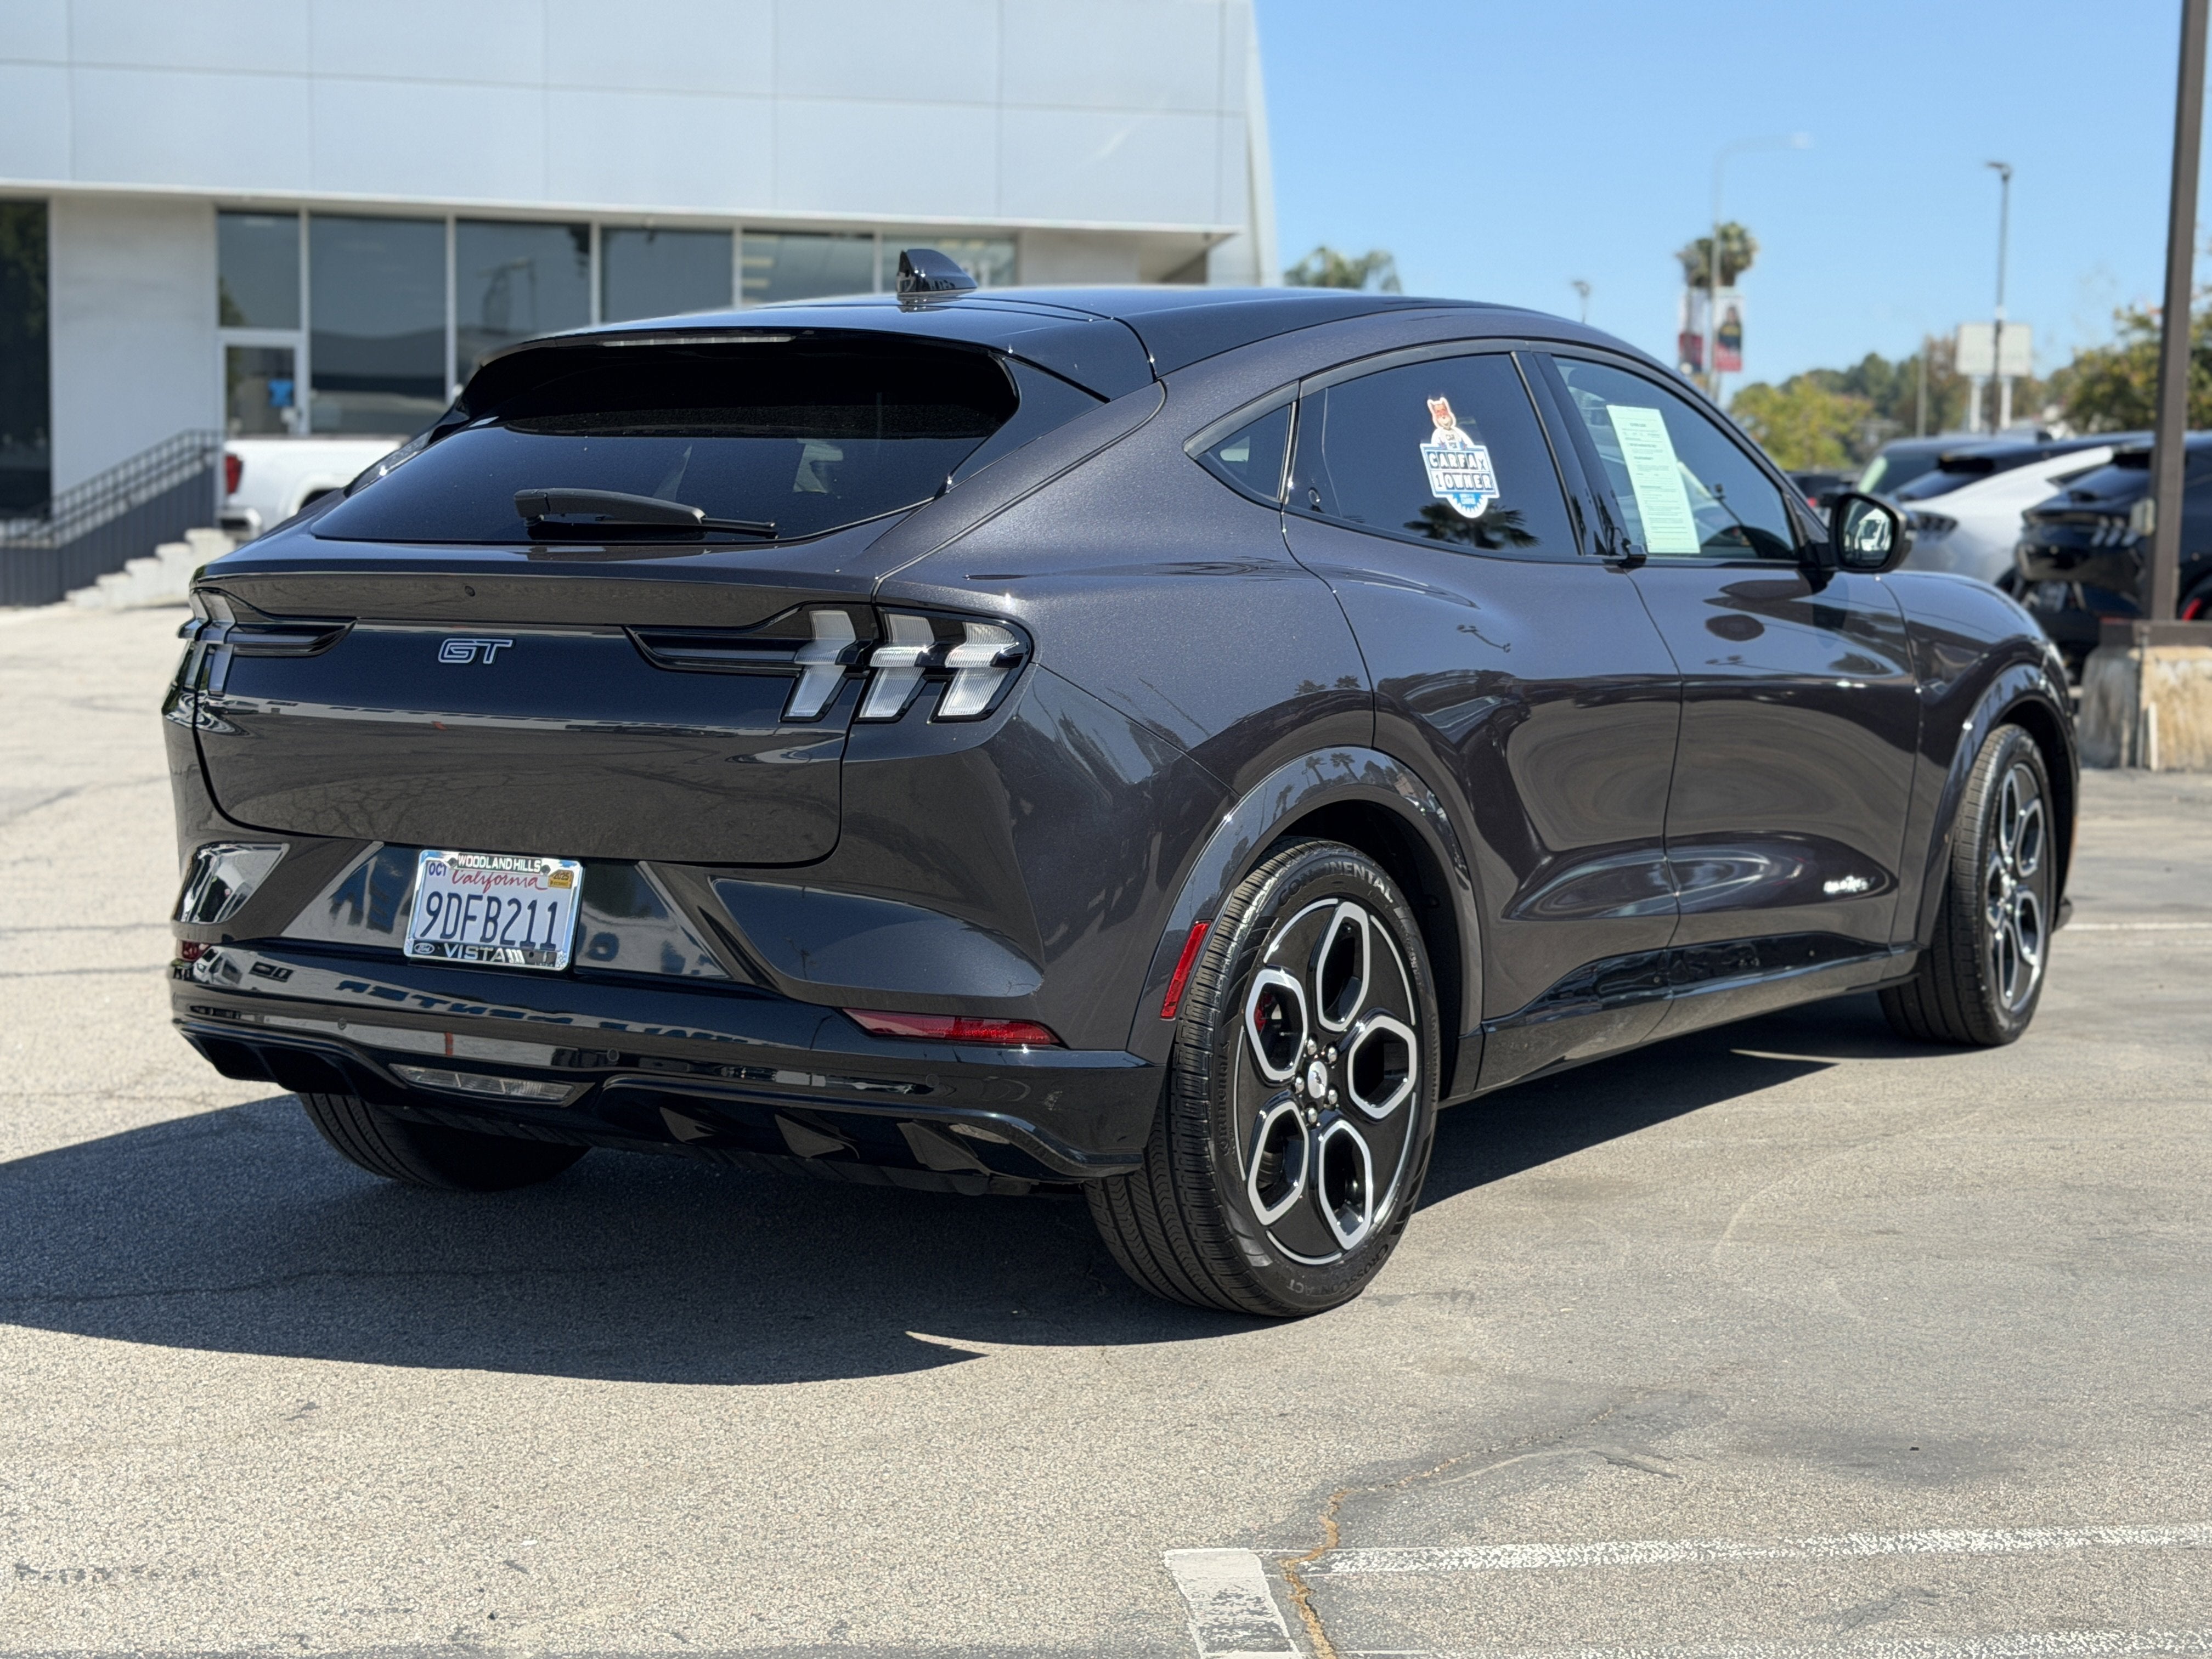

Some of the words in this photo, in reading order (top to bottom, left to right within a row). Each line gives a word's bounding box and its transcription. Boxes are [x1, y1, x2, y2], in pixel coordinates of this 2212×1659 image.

[1428, 452, 1487, 470] CARFAX
[1435, 474, 1443, 487] 1
[1443, 473, 1493, 489] OWNER
[438, 638, 514, 664] GT
[428, 862, 447, 877] OCT
[458, 855, 512, 870] WOODLAND
[513, 859, 541, 872] HILLS
[452, 869, 548, 894] California
[420, 890, 558, 951] 9DFB211
[443, 943, 506, 963] VISTA
